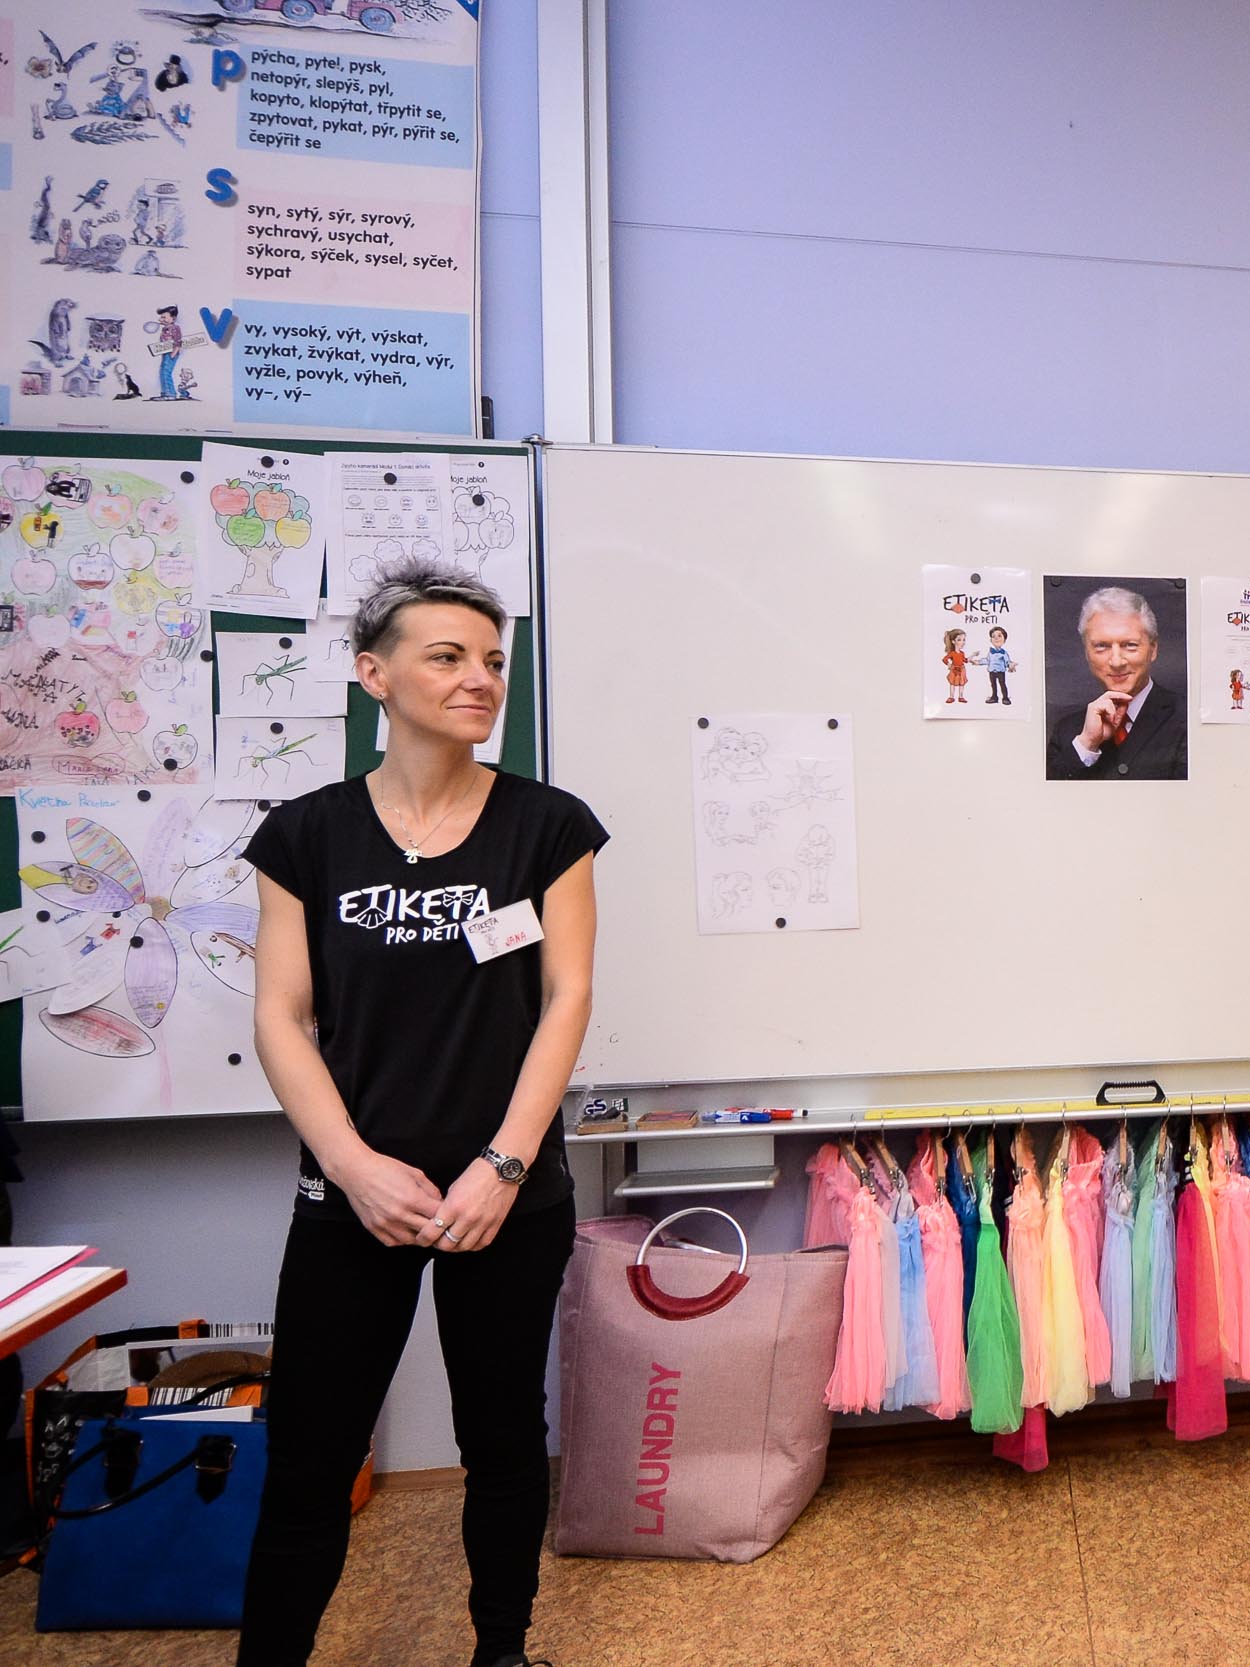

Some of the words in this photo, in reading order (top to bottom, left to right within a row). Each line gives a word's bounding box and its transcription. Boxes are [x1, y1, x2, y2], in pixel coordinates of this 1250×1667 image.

[251, 49, 300, 68] pýcha,
[349, 60, 387, 76] pysk,
[251, 70, 311, 90] netopýr,
[315, 77, 365, 95] slepýš,
[368, 82, 394, 97] pyl,
[250, 88, 305, 109] kopyto,
[309, 95, 373, 116] klopýtat,
[377, 102, 422, 121] třpytit
[426, 108, 447, 122] se,
[249, 111, 318, 131] zpytovat,
[322, 118, 367, 135] pykat,
[371, 122, 399, 139] pýr,
[402, 125, 435, 142] pýřit
[439, 130, 461, 144] se,
[249, 129, 301, 148] čepýřit
[304, 138, 321, 149] se
[247, 204, 281, 219] syn,
[286, 206, 323, 222] sytý,
[328, 208, 356, 224] sýr,
[360, 212, 416, 229] syrový,
[247, 224, 322, 242] sychravý,
[327, 230, 394, 247] usychat,
[246, 243, 305, 261] sýkora,
[310, 247, 360, 265] sýček,
[364, 252, 407, 268] sysel,
[412, 254, 458, 271] syčet,
[246, 265, 292, 280] sypat
[244, 323, 267, 337] vy,
[272, 325, 331, 341] vysoký,
[336, 328, 367, 344] výt,
[371, 329, 429, 347] výskat,
[244, 343, 303, 360] zvykat,
[307, 345, 366, 363] žvýkat,
[370, 351, 421, 367] vydra,
[425, 353, 455, 370] výr,
[244, 363, 291, 381] vyžle,
[296, 367, 349, 384] povyk,
[353, 369, 407, 387] výheň,
[247, 469, 266, 479] Moje
[943, 594, 1010, 614] ETIKETA
[338, 883, 490, 928] ETIKETA
[385, 926, 417, 945] PRO
[422, 917, 460, 942] DĚTI
[635, 1361, 681, 1536] LAUNDRY
